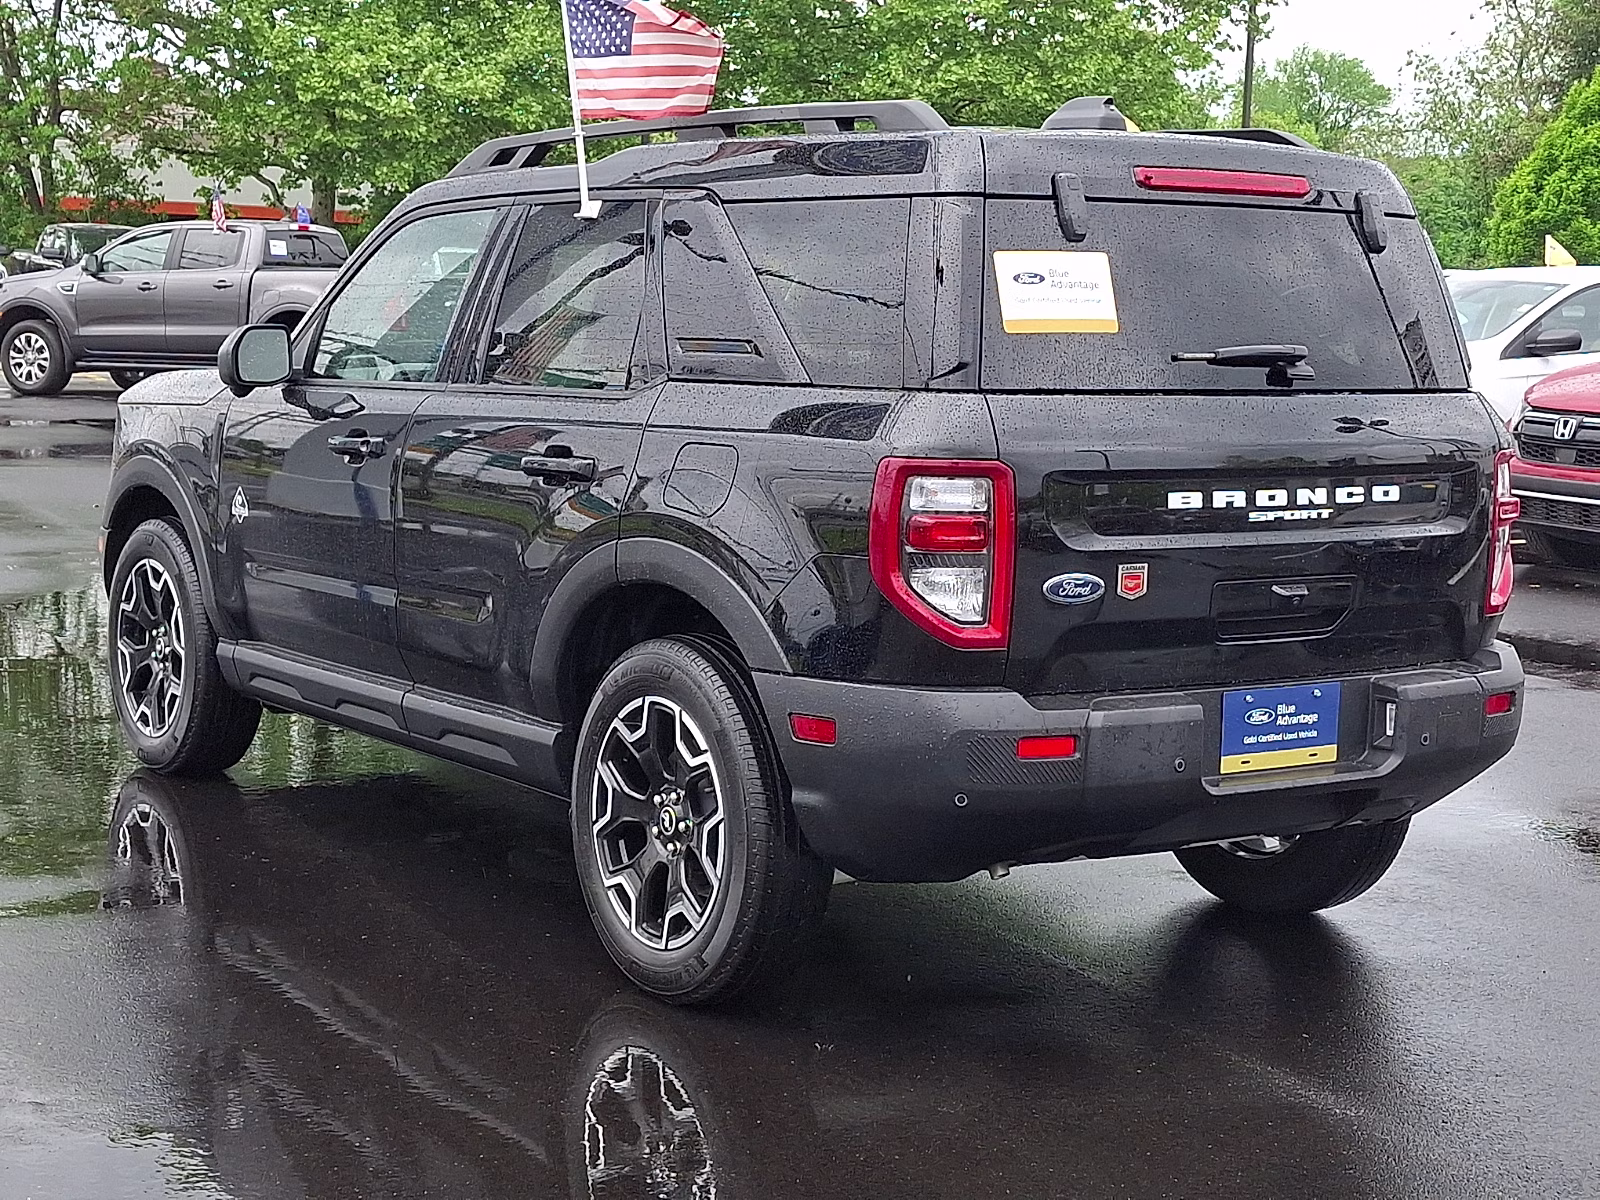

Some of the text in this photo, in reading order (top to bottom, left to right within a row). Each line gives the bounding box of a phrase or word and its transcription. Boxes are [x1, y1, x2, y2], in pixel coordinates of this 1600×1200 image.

[1048, 268, 1070, 278] Blue
[1050, 279, 1100, 291] Advantage
[1167, 484, 1401, 510] BRONCO
[1248, 508, 1334, 522] SPORT
[1276, 703, 1296, 715] Blue
[1276, 713, 1319, 726] Advantage
[1243, 736, 1257, 744] Gold
[1258, 733, 1282, 742] Certified
[1283, 731, 1298, 740] Used
